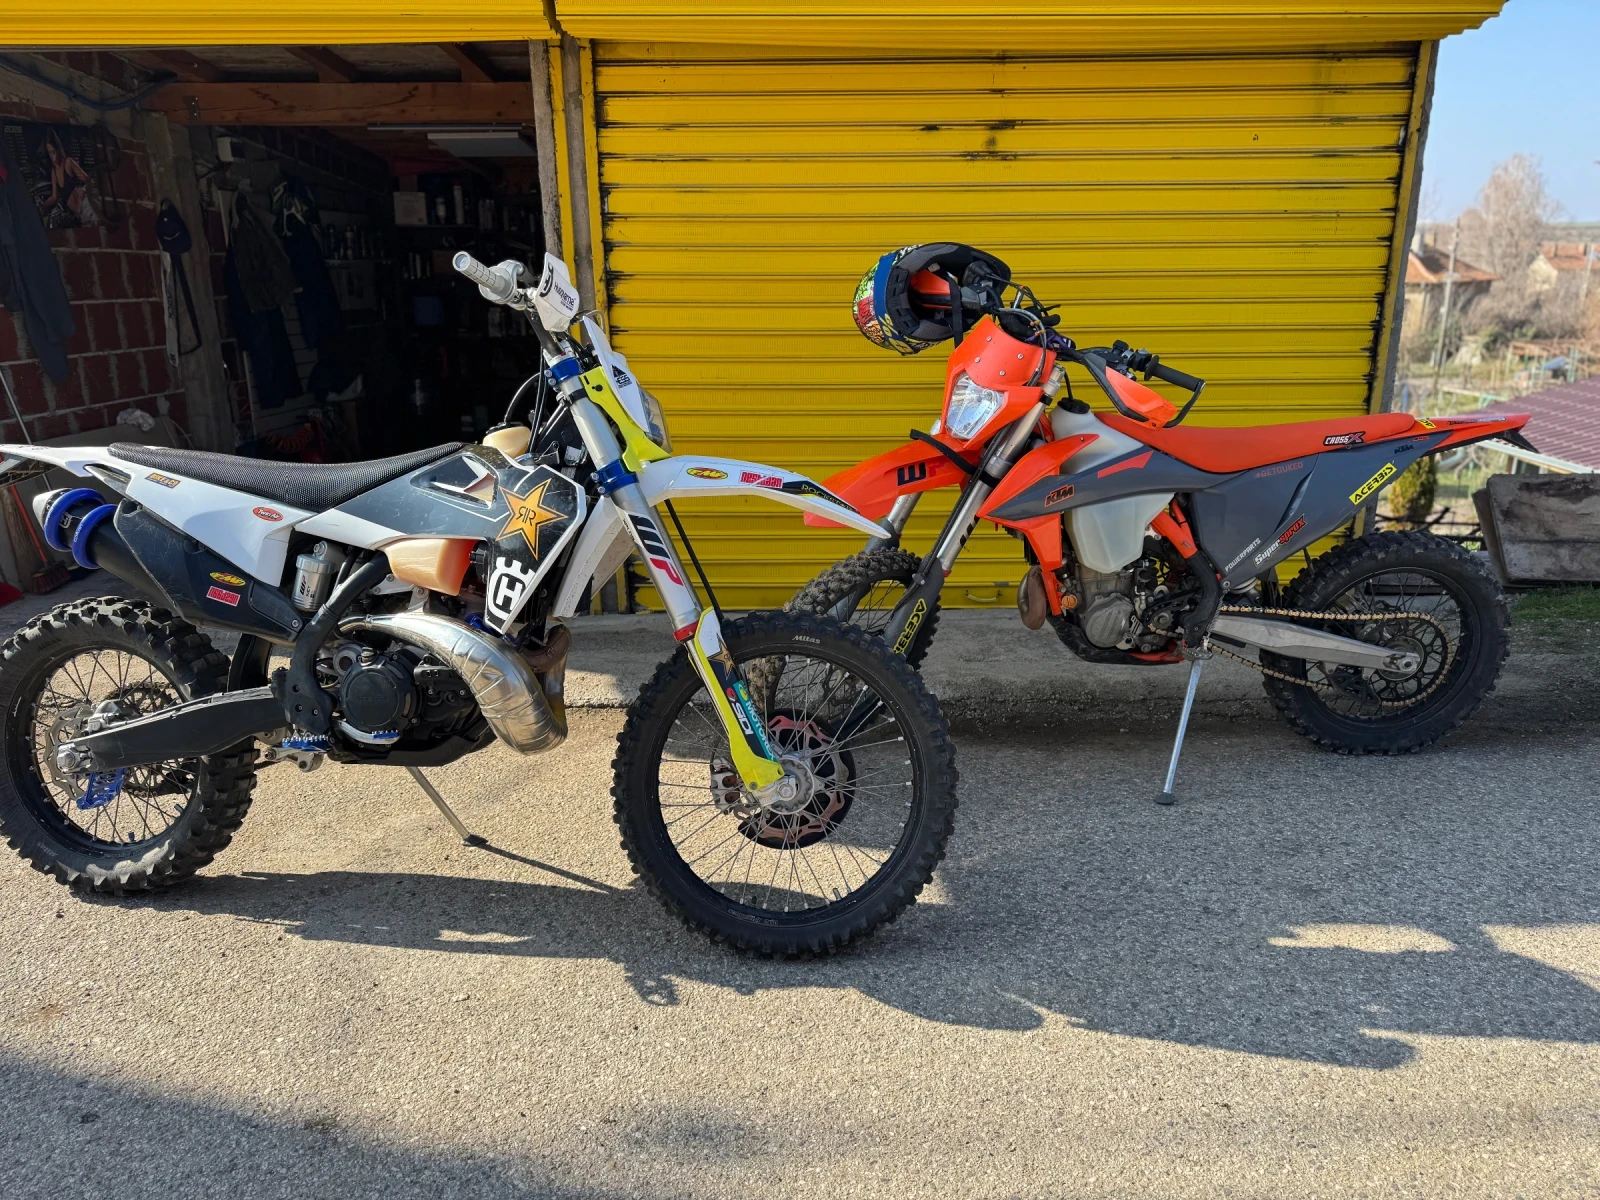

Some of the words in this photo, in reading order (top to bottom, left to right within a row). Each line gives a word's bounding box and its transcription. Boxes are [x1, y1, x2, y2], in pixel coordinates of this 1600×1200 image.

[1044, 485, 1075, 507] KTM
[1354, 466, 1394, 503] ACERBIS
[627, 514, 685, 587] WP
[1224, 537, 1262, 572] POWERPARTS
[791, 634, 822, 644] Mitas
[744, 701, 775, 761] MOTOREX
